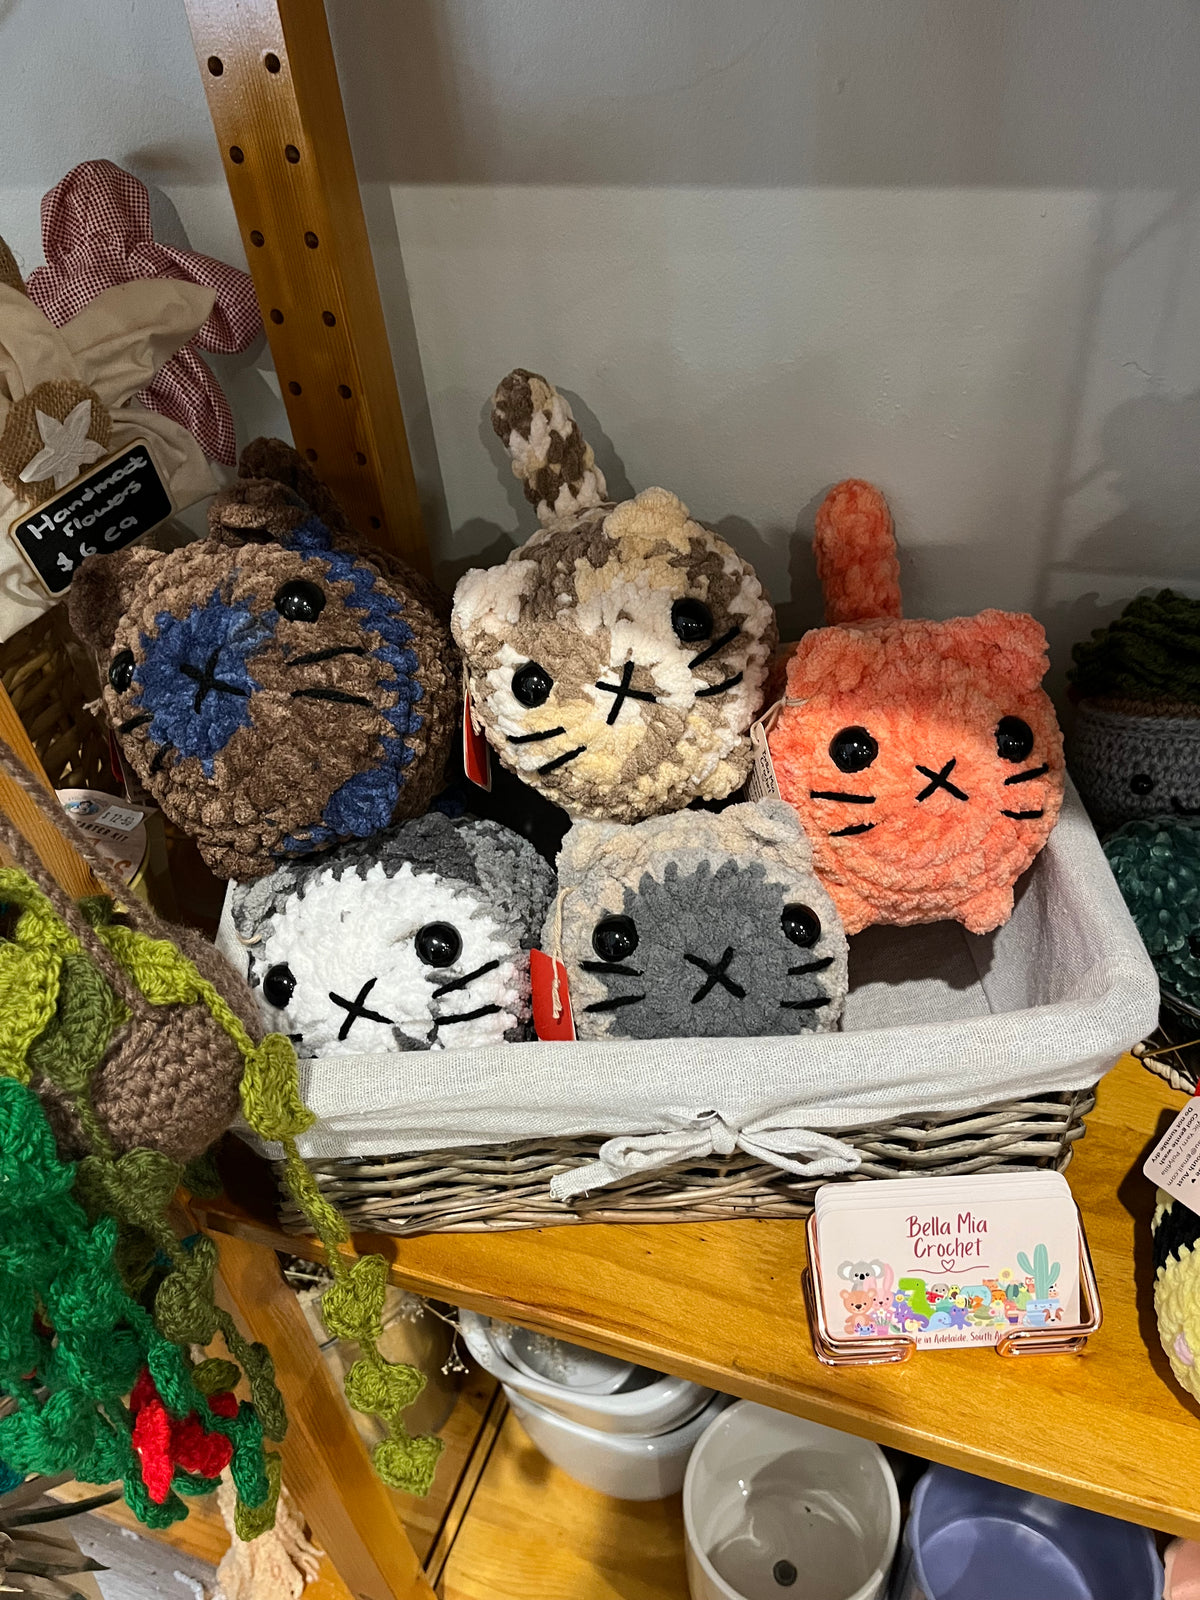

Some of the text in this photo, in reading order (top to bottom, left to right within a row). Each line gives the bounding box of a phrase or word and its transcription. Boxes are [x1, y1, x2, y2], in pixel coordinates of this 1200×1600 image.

[75, 820, 111, 836] TARTER
[110, 832, 129, 842] KIT
[1151, 1106, 1194, 1164] Do not tumble dry
[1159, 1112, 1198, 1166] Cool gentle wash
[1188, 1155, 1200, 1172] outh
[1176, 1170, 1190, 1187] Aust
[905, 1211, 988, 1238] Bella Mia
[913, 1237, 983, 1259] Crochet
[970, 1331, 992, 1342] South
